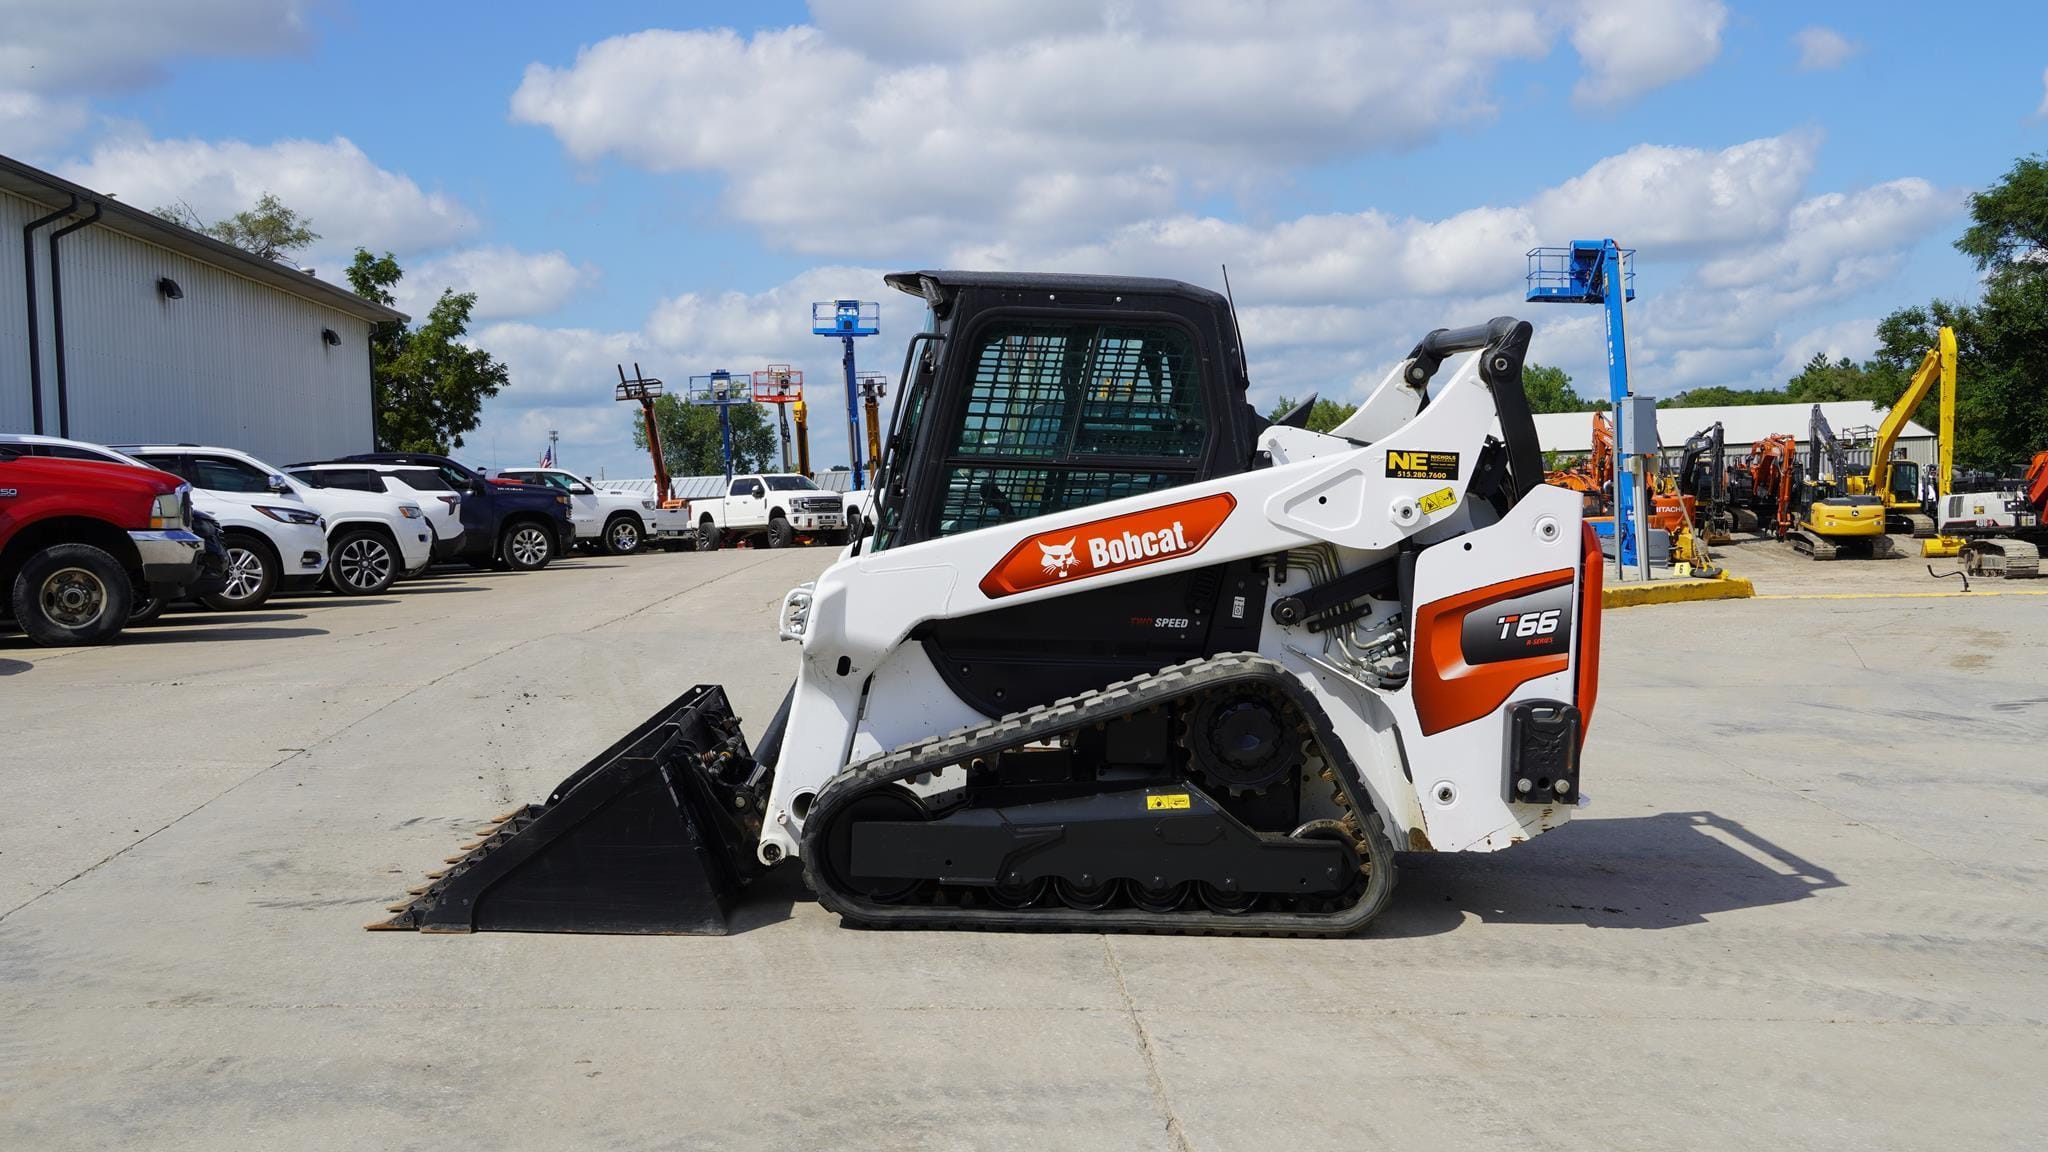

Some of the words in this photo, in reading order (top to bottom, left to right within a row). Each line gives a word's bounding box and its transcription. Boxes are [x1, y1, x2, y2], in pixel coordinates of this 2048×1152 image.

[1388, 452, 1429, 471] NE
[1397, 470, 1447, 479] 515.280.7600
[1088, 521, 1187, 568] Bobcat
[1154, 617, 1189, 629] SPEED
[1498, 609, 1561, 640] T66
[1526, 637, 1553, 646] R-SERIES
